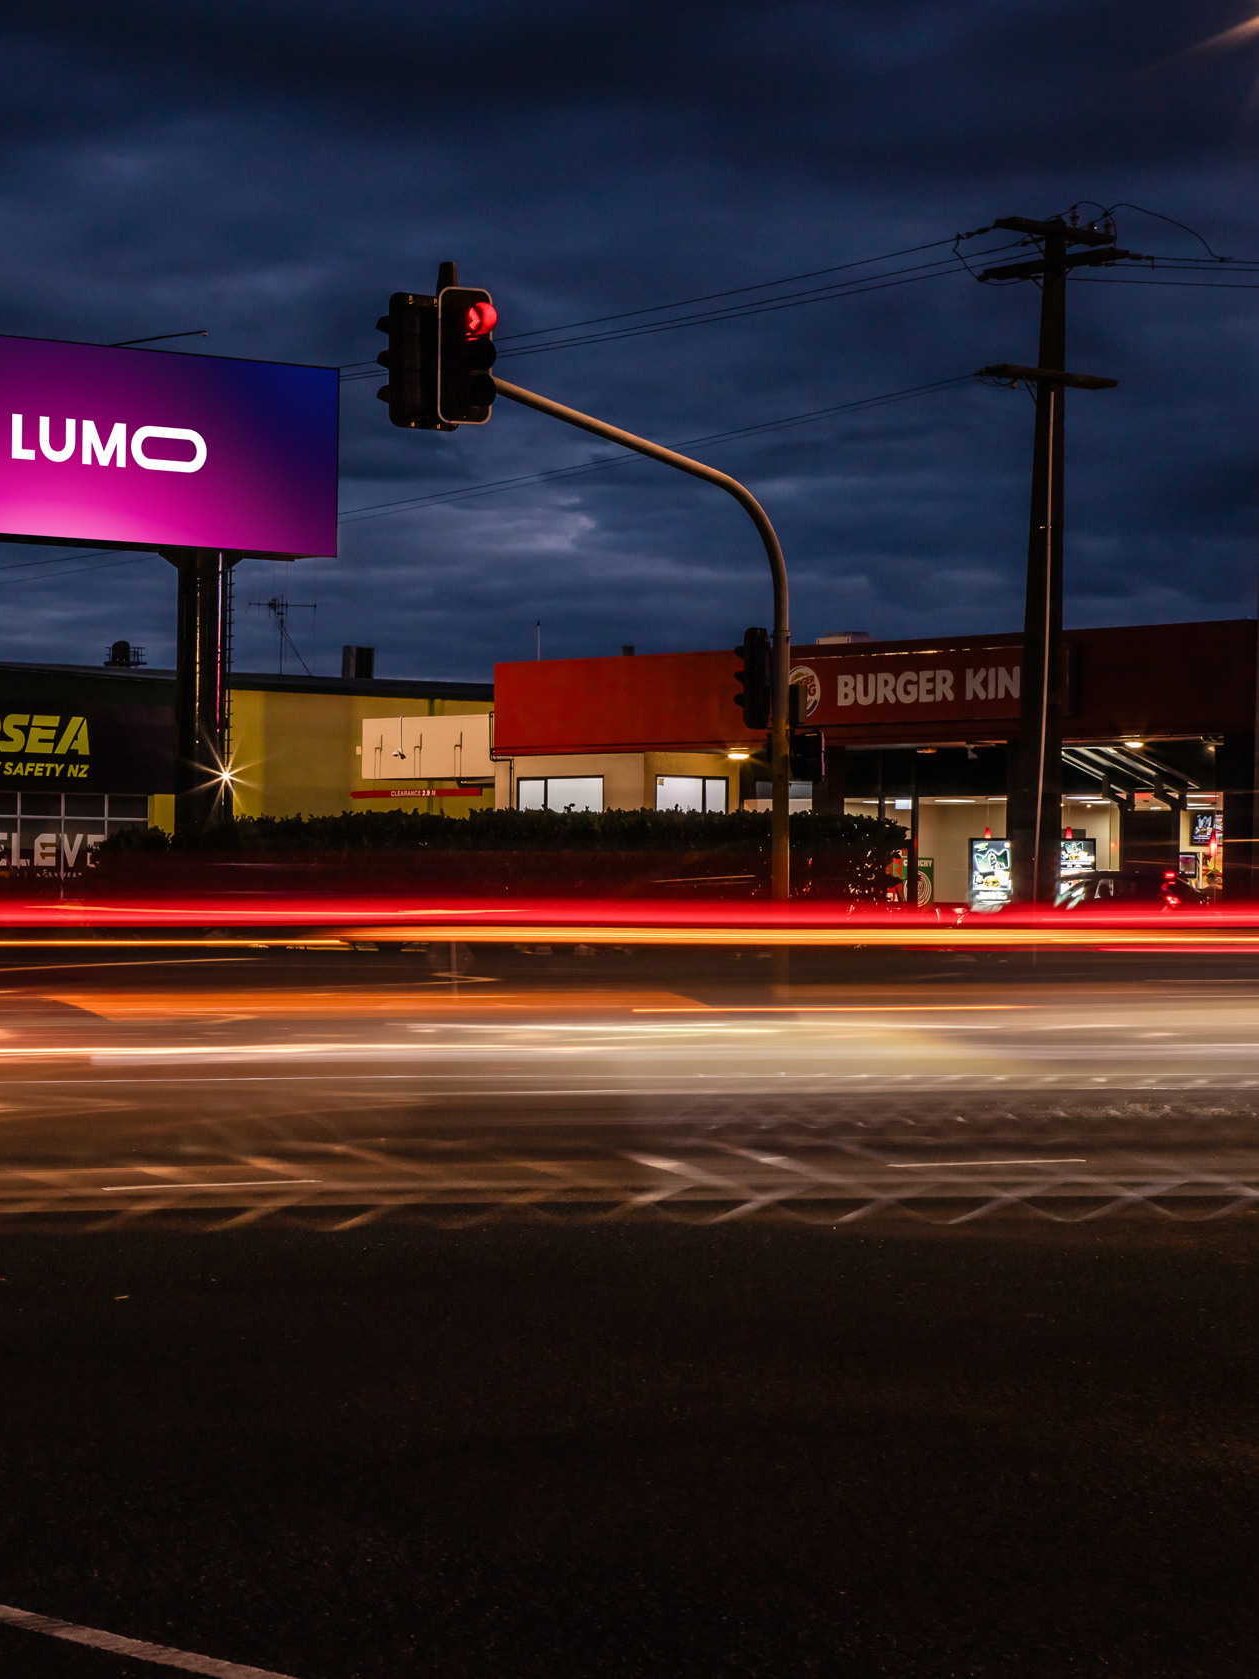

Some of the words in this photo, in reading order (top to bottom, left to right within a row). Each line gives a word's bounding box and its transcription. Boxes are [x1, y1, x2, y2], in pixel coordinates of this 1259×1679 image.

[12, 413, 207, 473] LUMO
[837, 669, 954, 706] BURGER
[965, 666, 1020, 701] KIN
[3, 761, 65, 777] SAFETY
[67, 763, 89, 778] NZ
